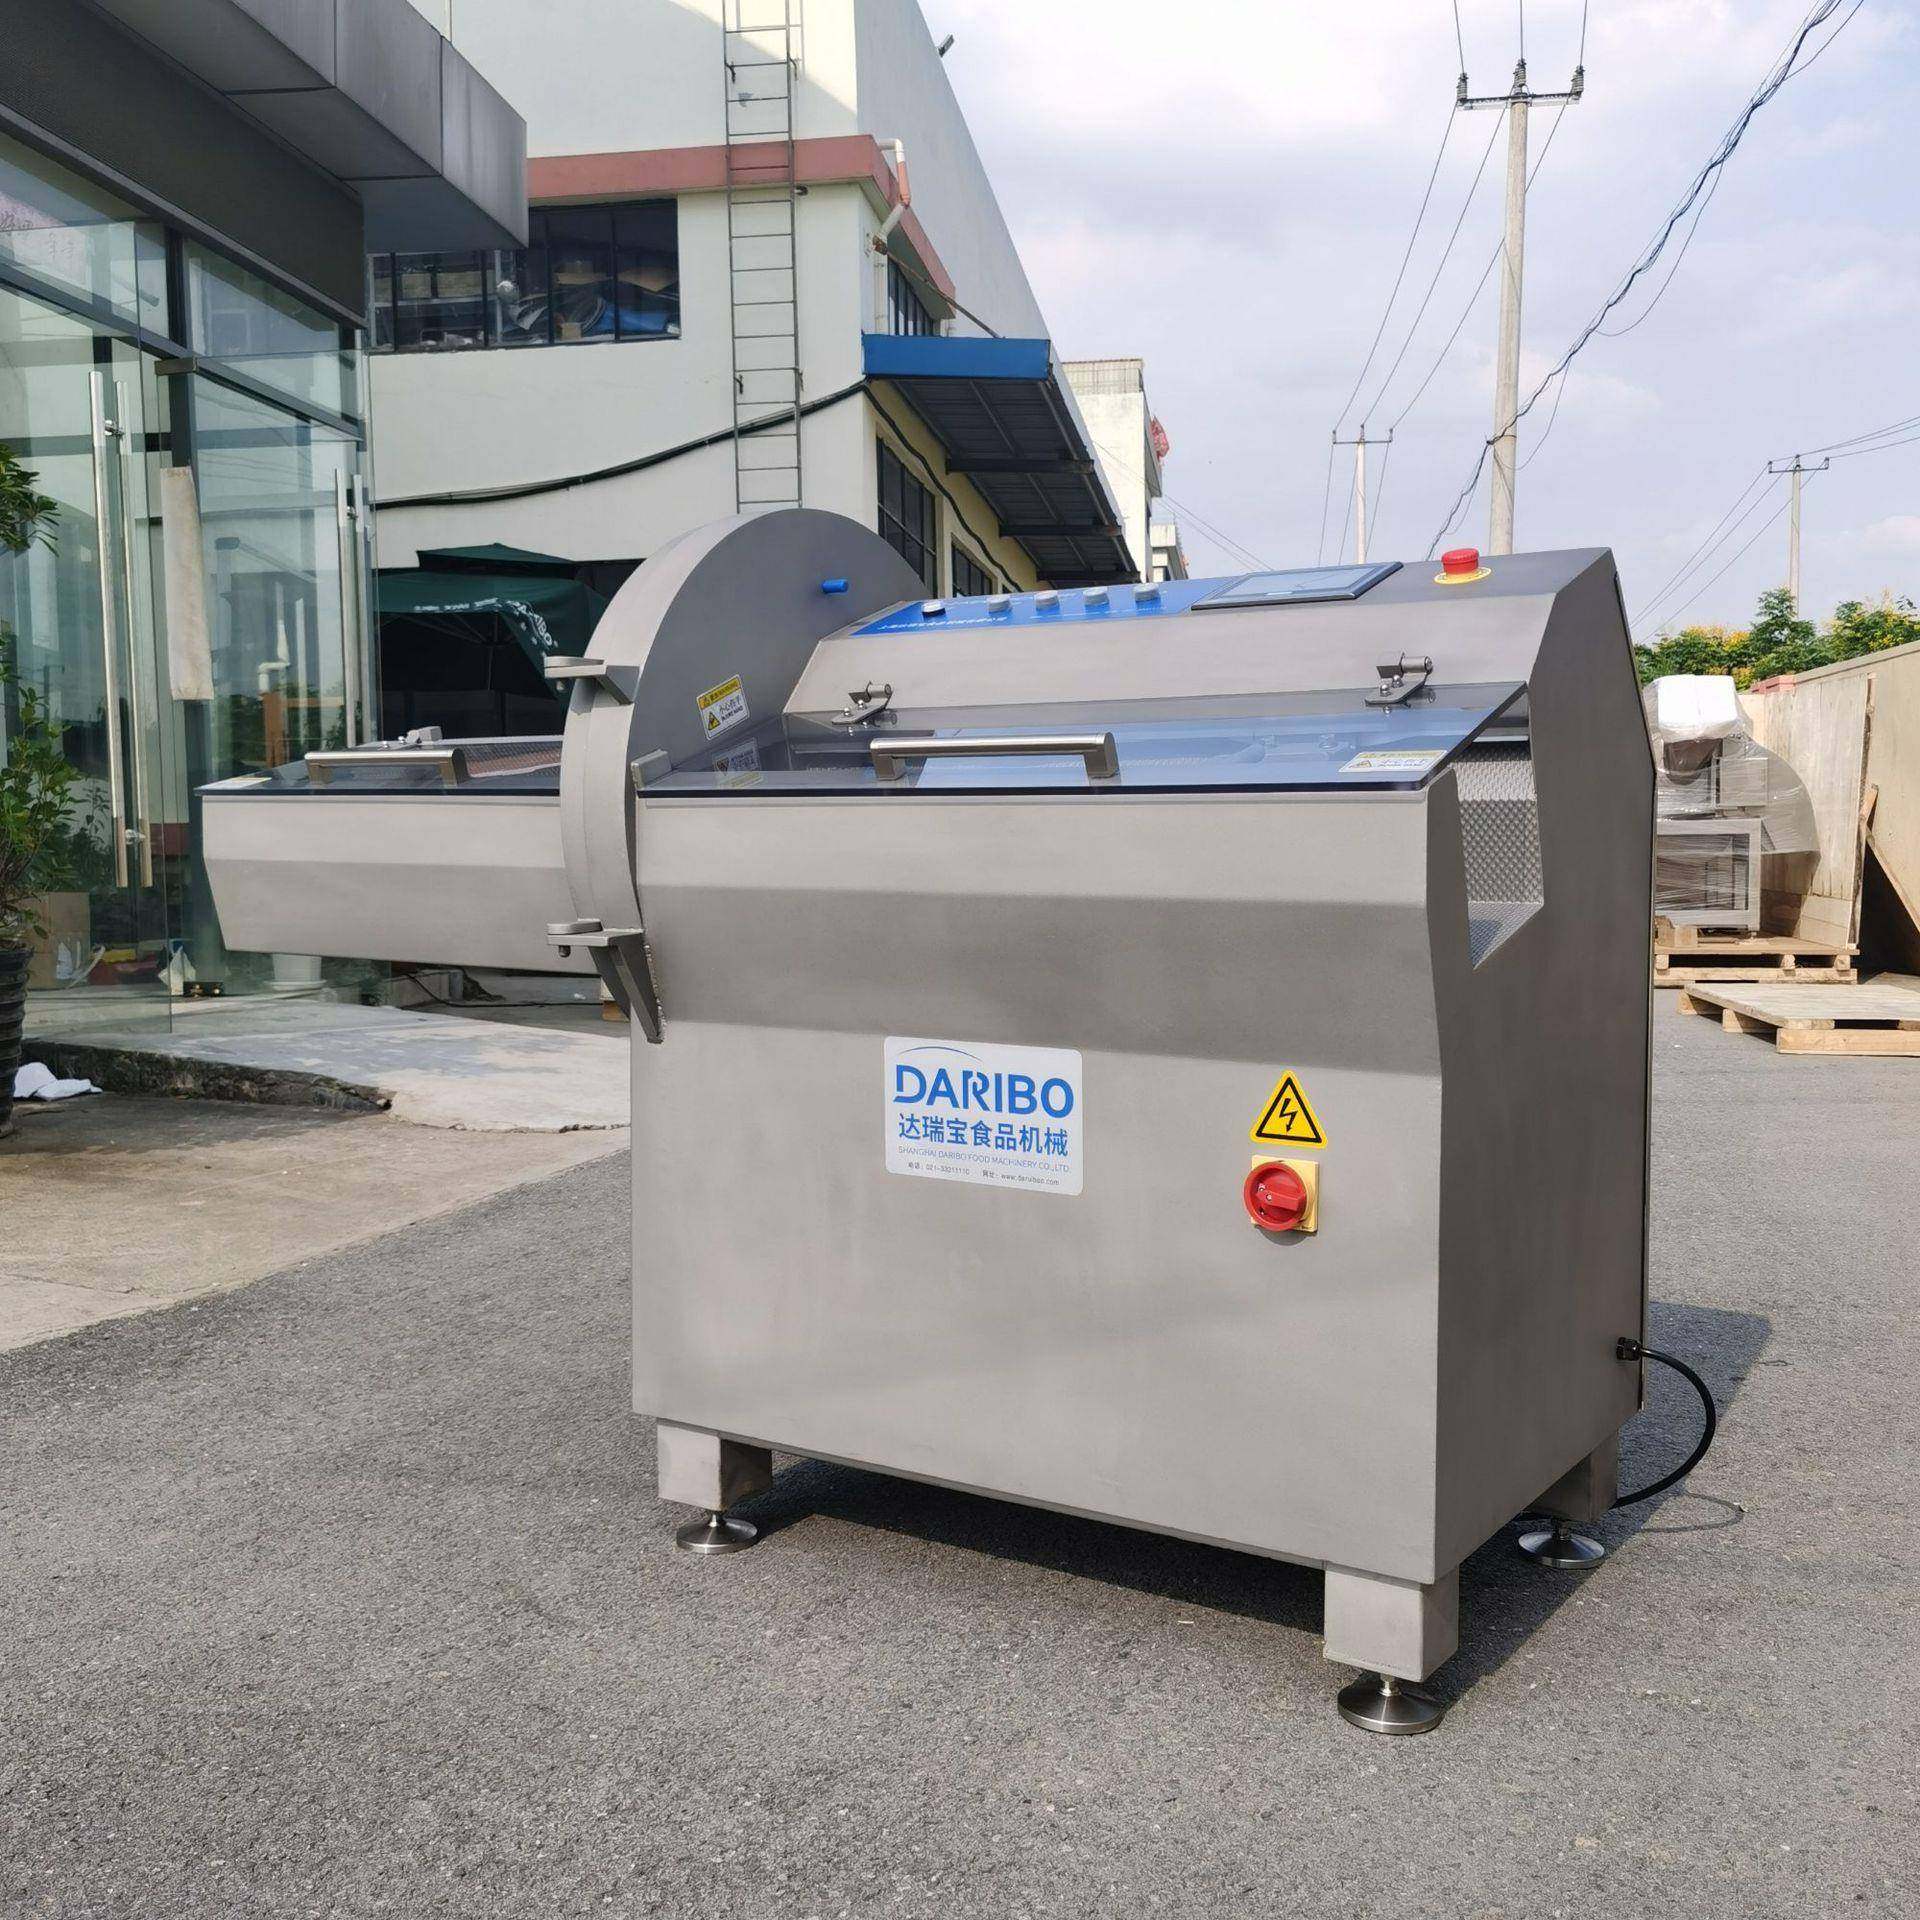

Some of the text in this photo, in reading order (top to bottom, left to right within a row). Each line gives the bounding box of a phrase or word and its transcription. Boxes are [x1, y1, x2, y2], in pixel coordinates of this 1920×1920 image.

[893, 1064, 1074, 1119] DARIBO
[898, 1113, 1069, 1157] 达瑞宝食品机械
[898, 1145, 937, 1157] SHANGHAI
[938, 1151, 967, 1161] DARIBO
[967, 1153, 990, 1163] FOOD
[992, 1156, 1037, 1168] MACHINERY
